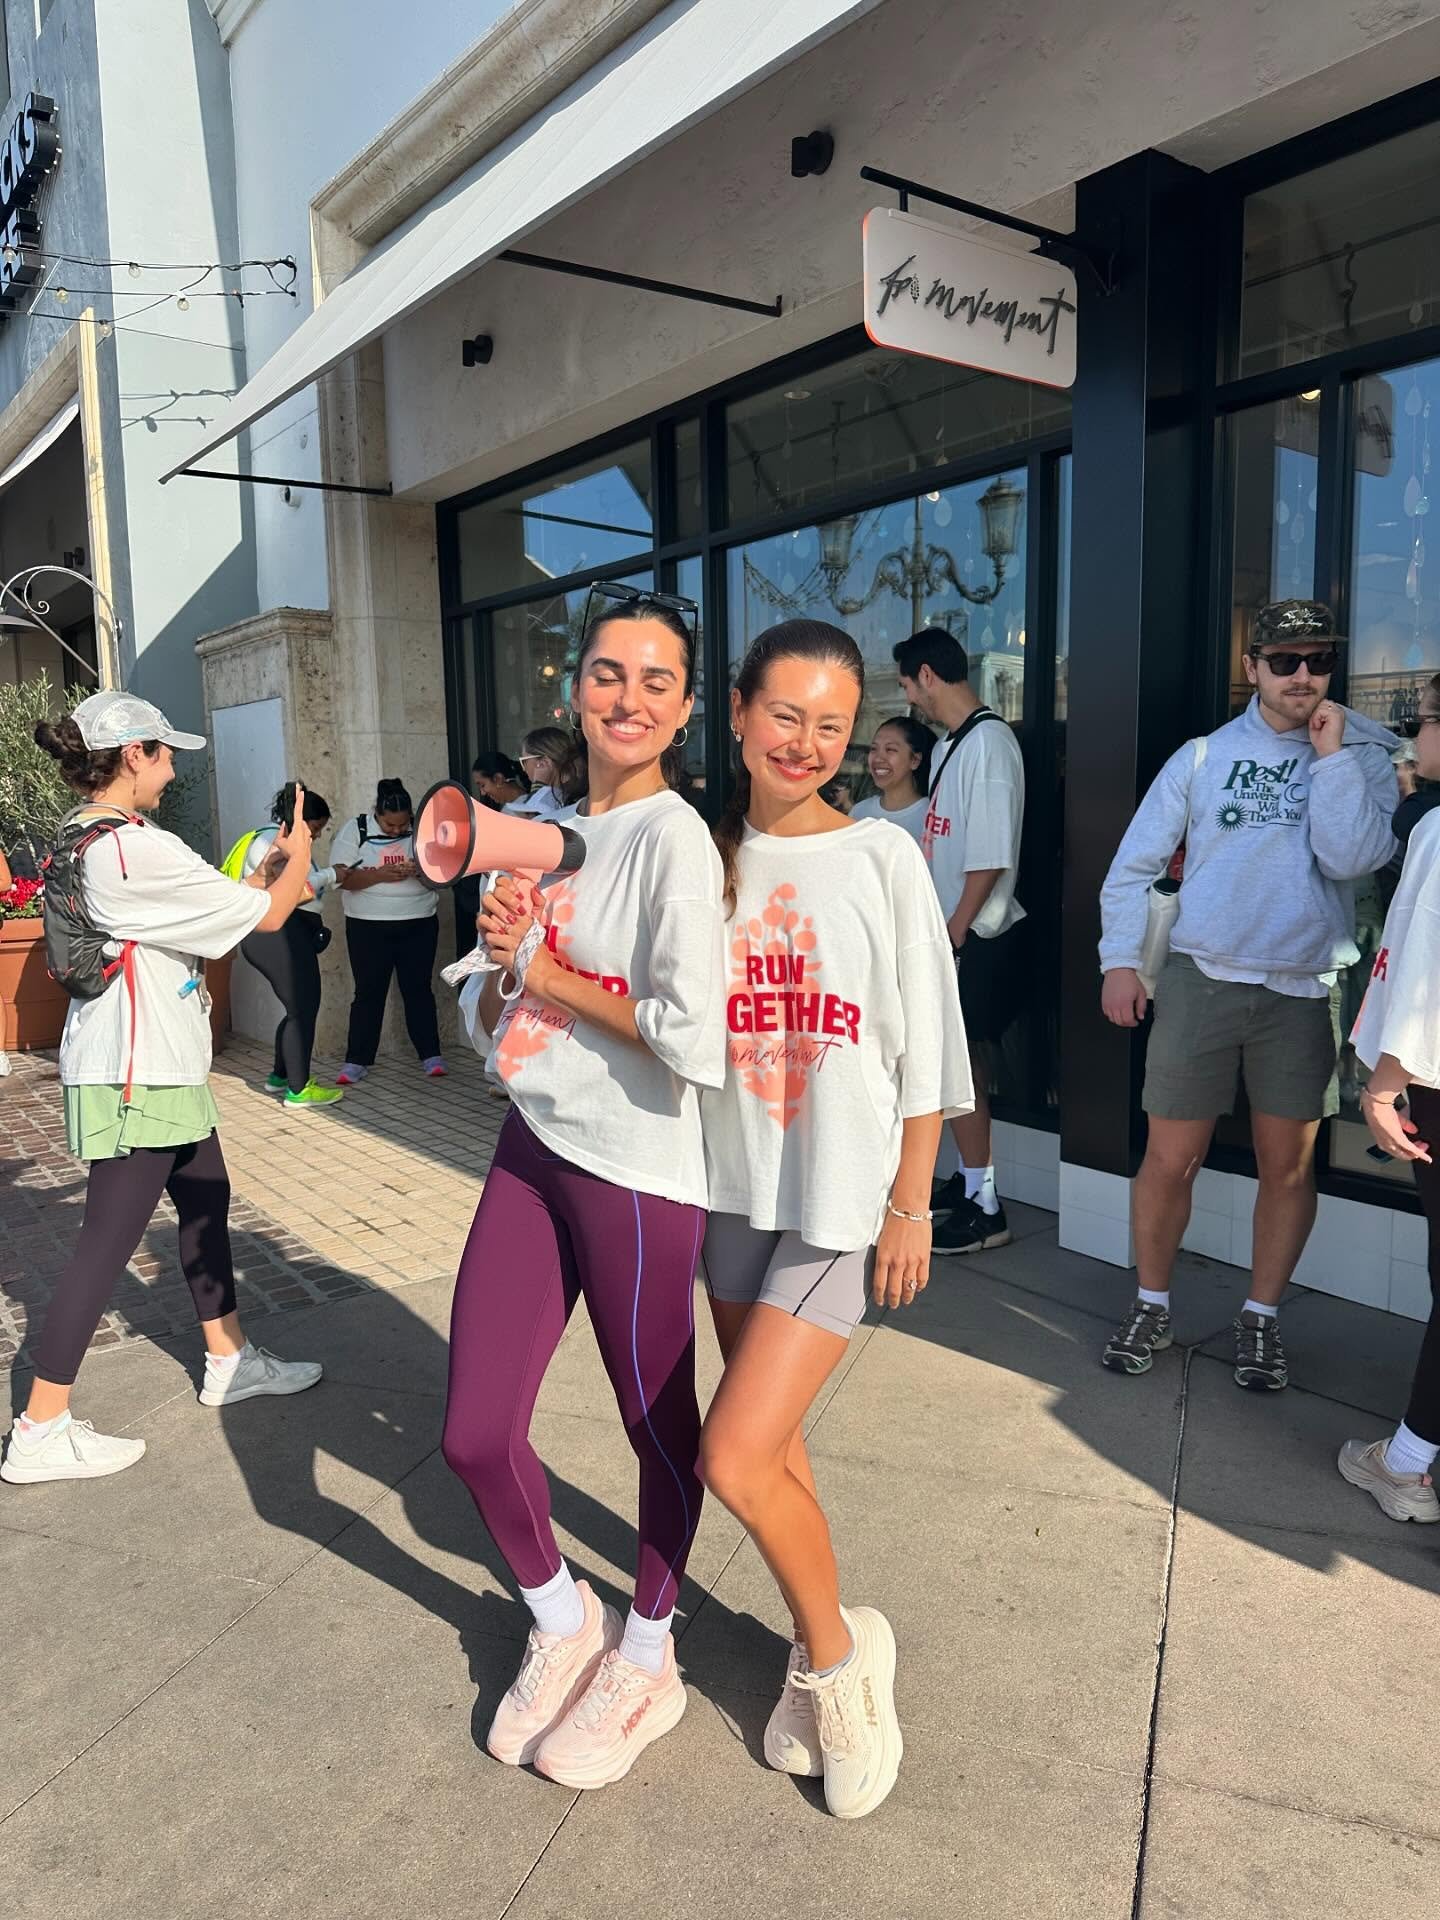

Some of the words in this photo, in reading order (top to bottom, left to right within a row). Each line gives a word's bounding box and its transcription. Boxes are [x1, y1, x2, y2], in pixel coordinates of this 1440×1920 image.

[1221, 758, 1298, 790] Rest!
[383, 855, 405, 865] RUN
[746, 954, 805, 986] RUN
[726, 991, 861, 1046] GETHER
[621, 1695, 652, 1740] HOKA
